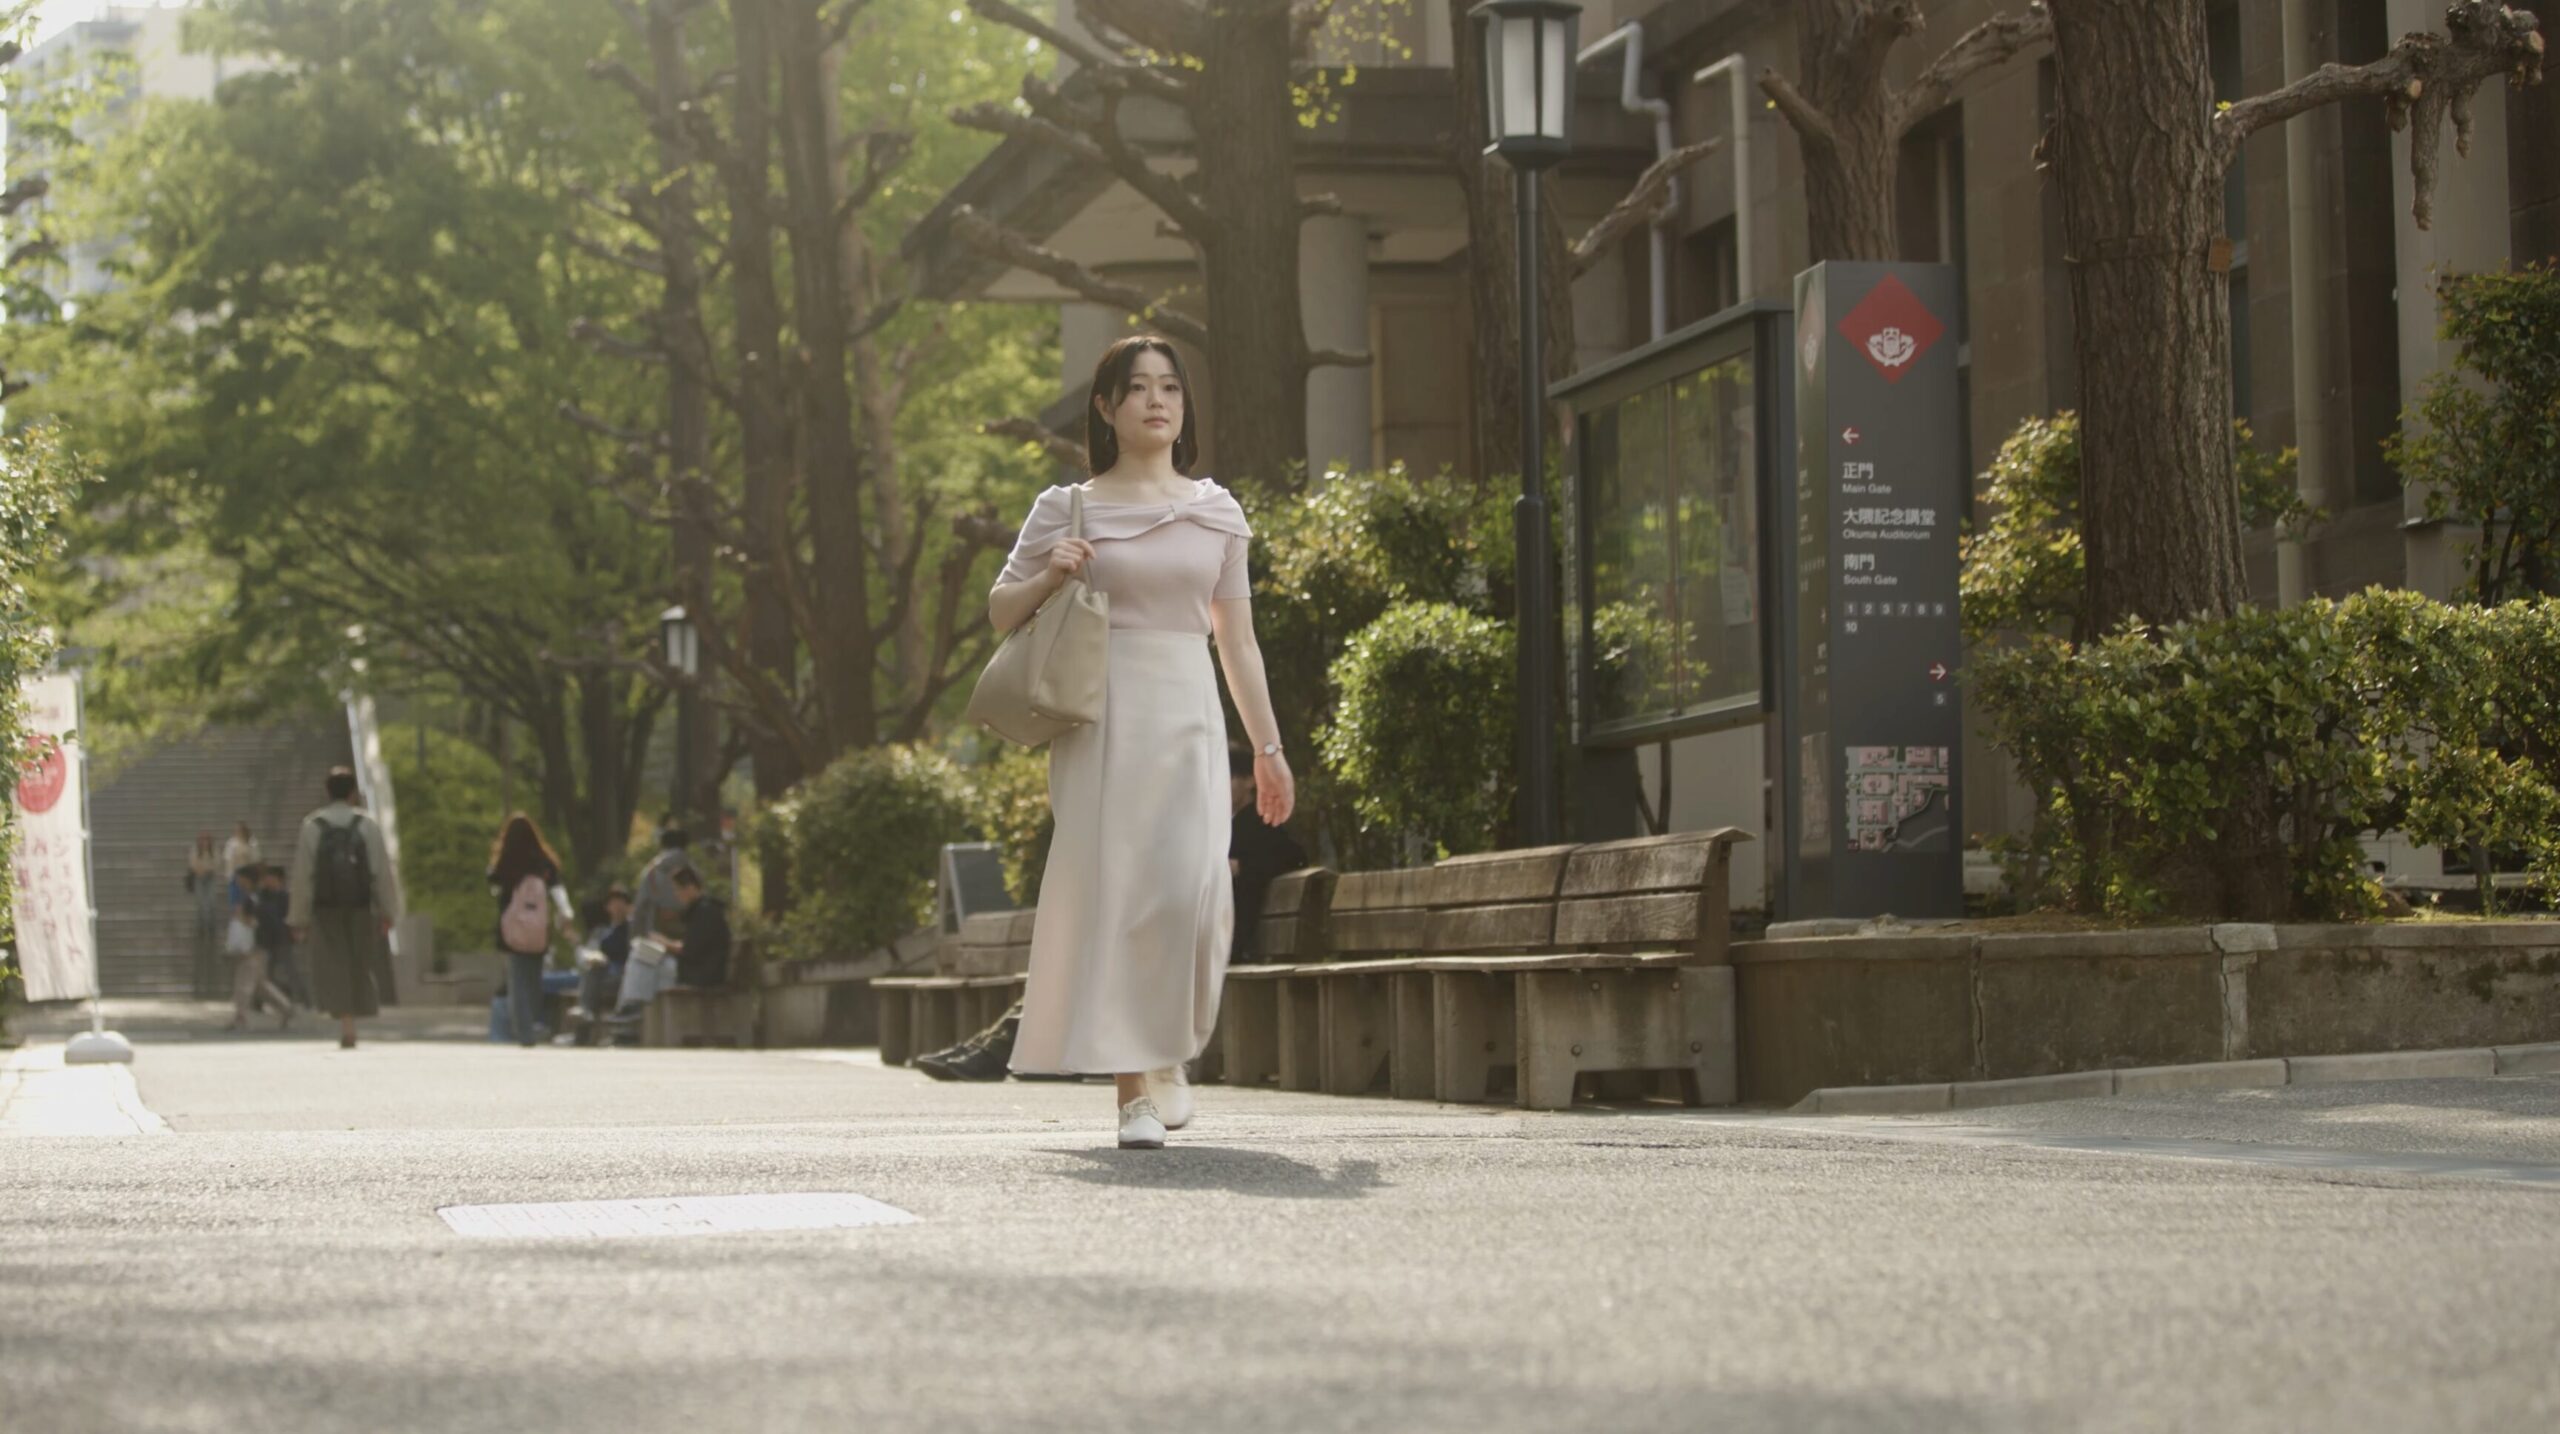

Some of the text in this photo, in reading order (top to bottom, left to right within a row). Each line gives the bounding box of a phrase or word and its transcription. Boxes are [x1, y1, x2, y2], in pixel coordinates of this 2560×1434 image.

[1842, 462, 1874, 480] 正門
[1842, 483, 1892, 494] Main Gate
[1843, 508, 1936, 526] 大隈記念講堂
[1842, 529, 1930, 539] Okuma Auditorium
[1843, 553, 1875, 571] 南門
[1843, 574, 1898, 585] South Gate
[1864, 603, 1873, 615] 2
[1882, 603, 1891, 615] 3
[1900, 603, 1909, 615] 7
[1917, 603, 1926, 615] 8
[1935, 603, 1944, 615] 9
[1845, 621, 1858, 633] 10
